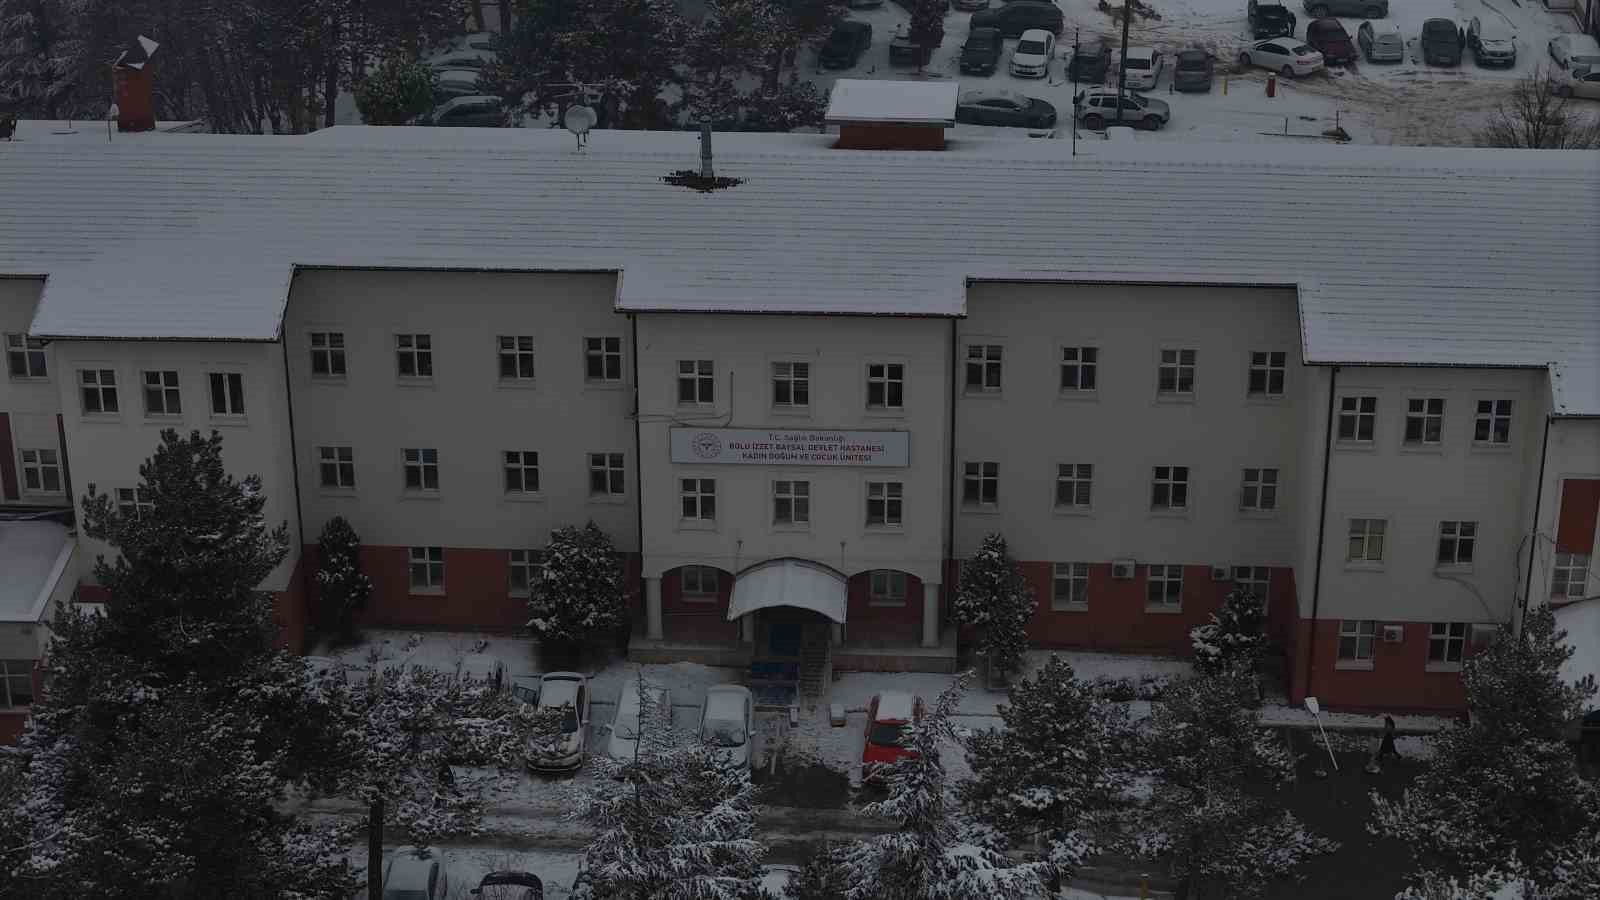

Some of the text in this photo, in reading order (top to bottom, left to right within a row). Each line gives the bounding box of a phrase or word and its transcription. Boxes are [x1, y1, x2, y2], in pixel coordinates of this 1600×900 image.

[729, 442, 751, 450] BOLU
[775, 443, 806, 451] BAYSAL
[742, 452, 767, 460] KADIN
[768, 452, 798, 461] DOĞUM
[799, 453, 809, 461] VE
